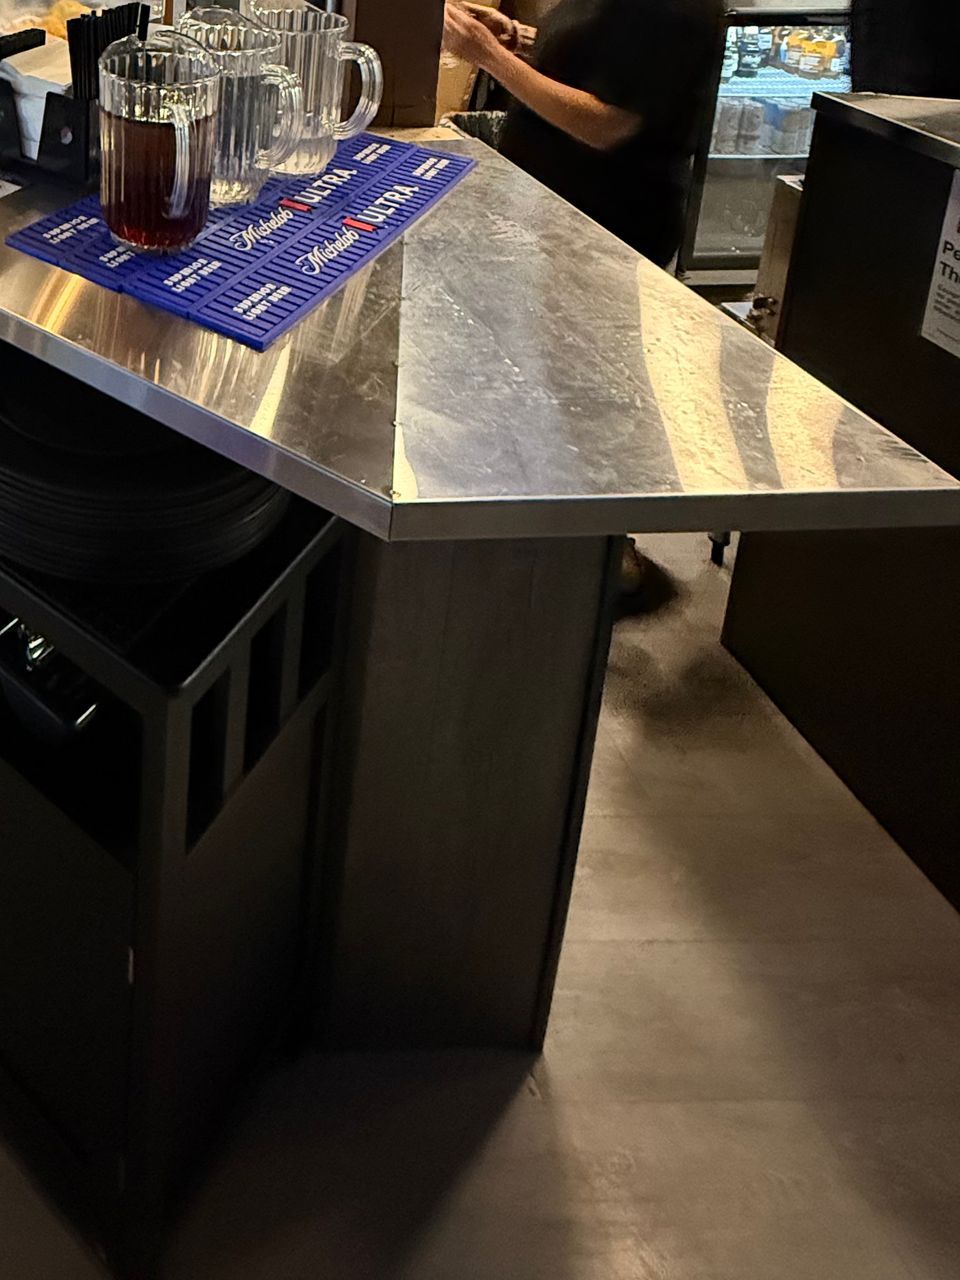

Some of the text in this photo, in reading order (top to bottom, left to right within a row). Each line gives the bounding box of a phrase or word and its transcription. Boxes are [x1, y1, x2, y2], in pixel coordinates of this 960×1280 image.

[228, 167, 358, 252] Michelob ULTRA
[295, 184, 420, 275] Michelob ULTRA
[163, 258, 209, 286] SUPERIOR
[171, 260, 222, 293] LIGHT BEER
[233, 283, 277, 314] SUPERIOR
[242, 286, 292, 321] LIGHT BEER
